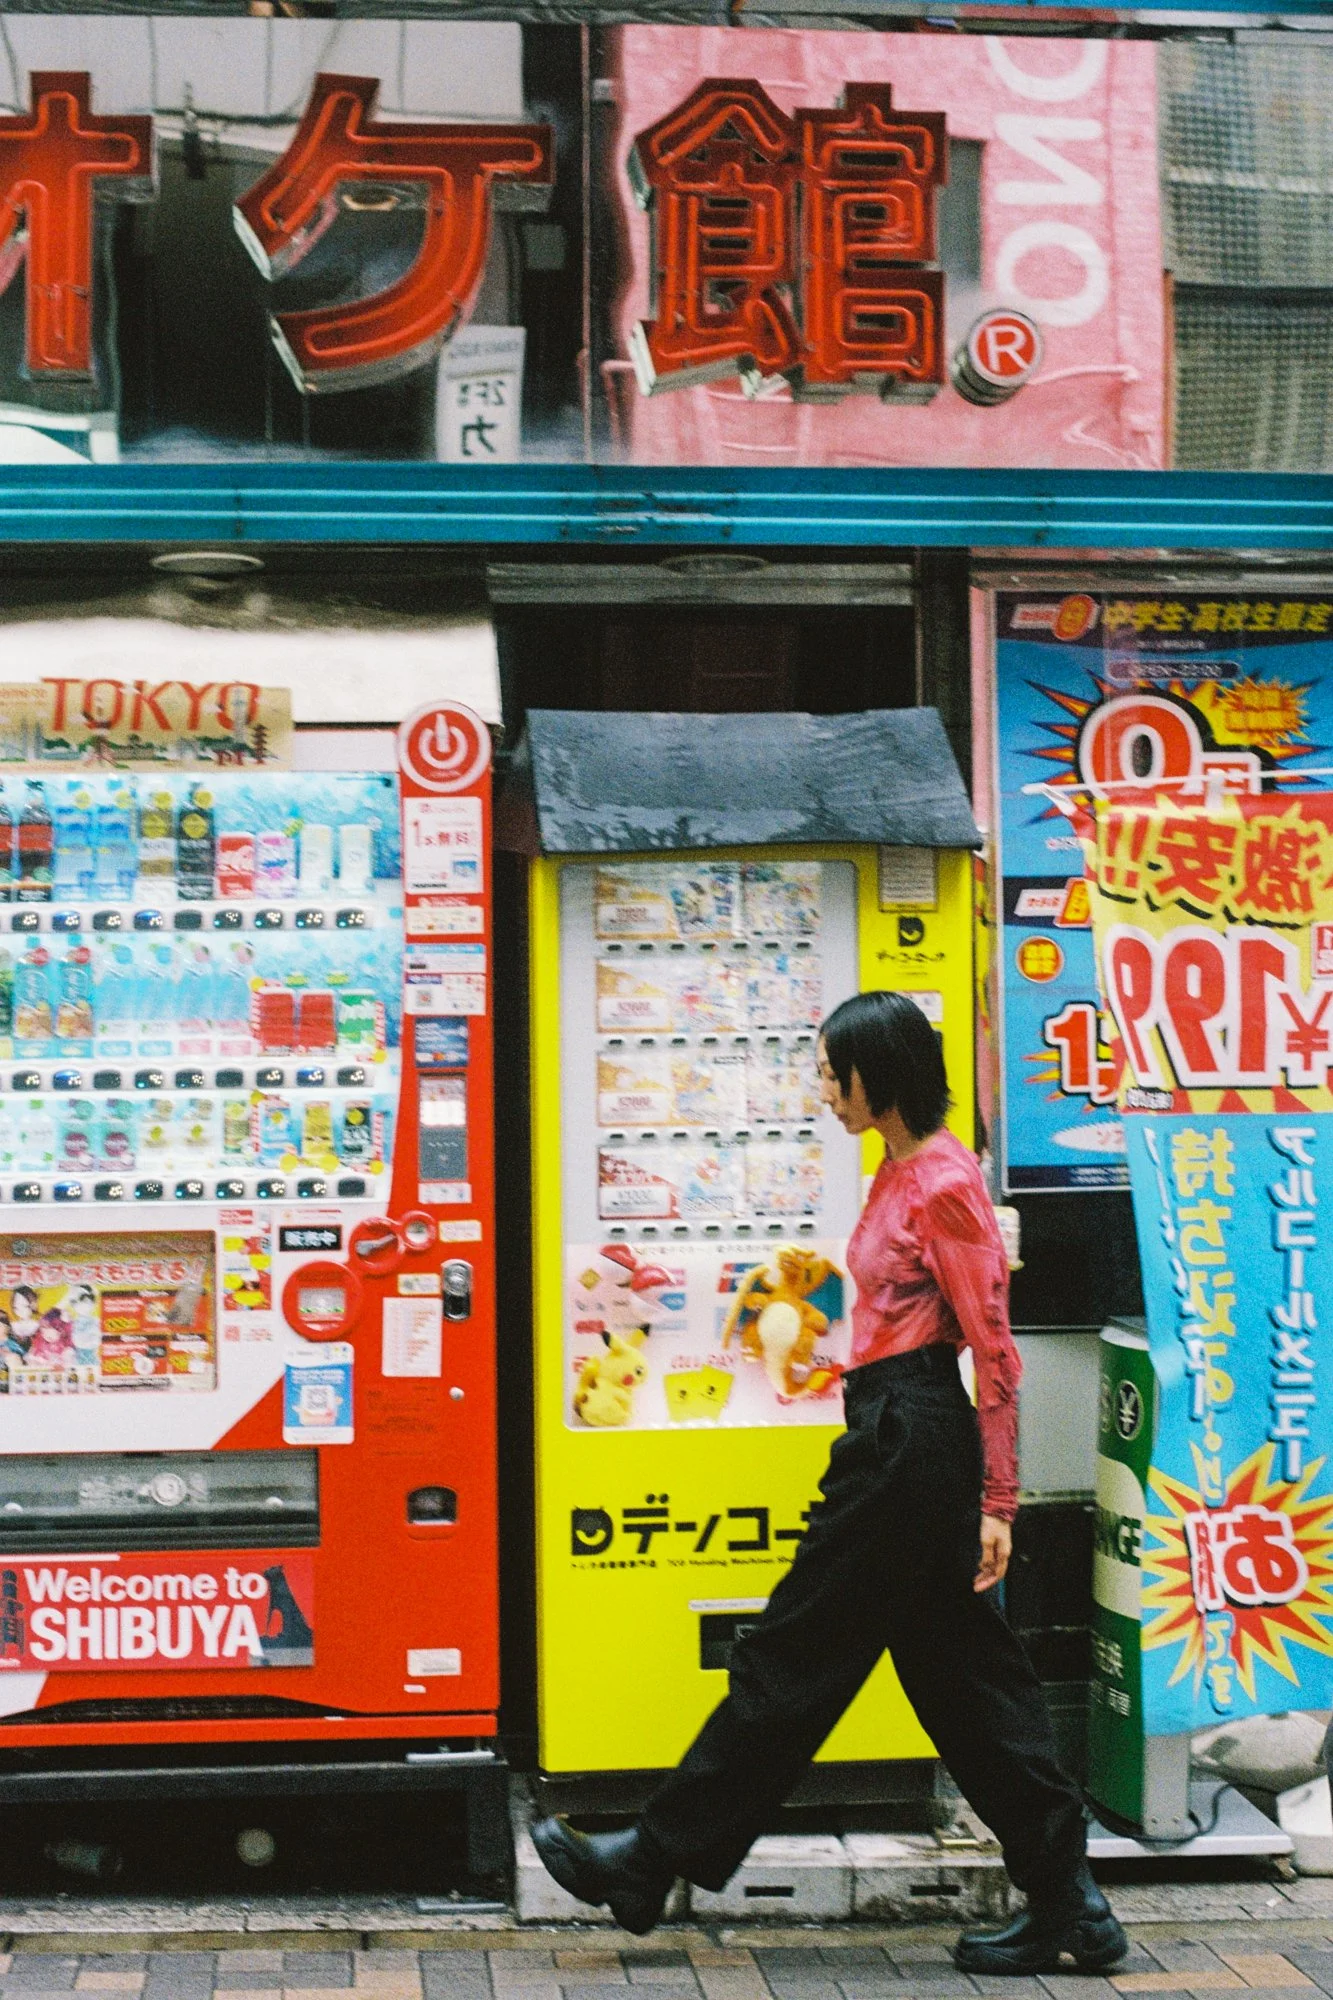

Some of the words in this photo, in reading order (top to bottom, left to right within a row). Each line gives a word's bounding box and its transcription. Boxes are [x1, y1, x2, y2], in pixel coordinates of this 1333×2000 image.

[41, 677, 262, 733] TOKYO
[622, 1493, 817, 1554] デンコー
[24, 1568, 218, 1603] Welcome
[225, 1566, 269, 1600] to
[30, 1604, 264, 1662] SHIBUYA
